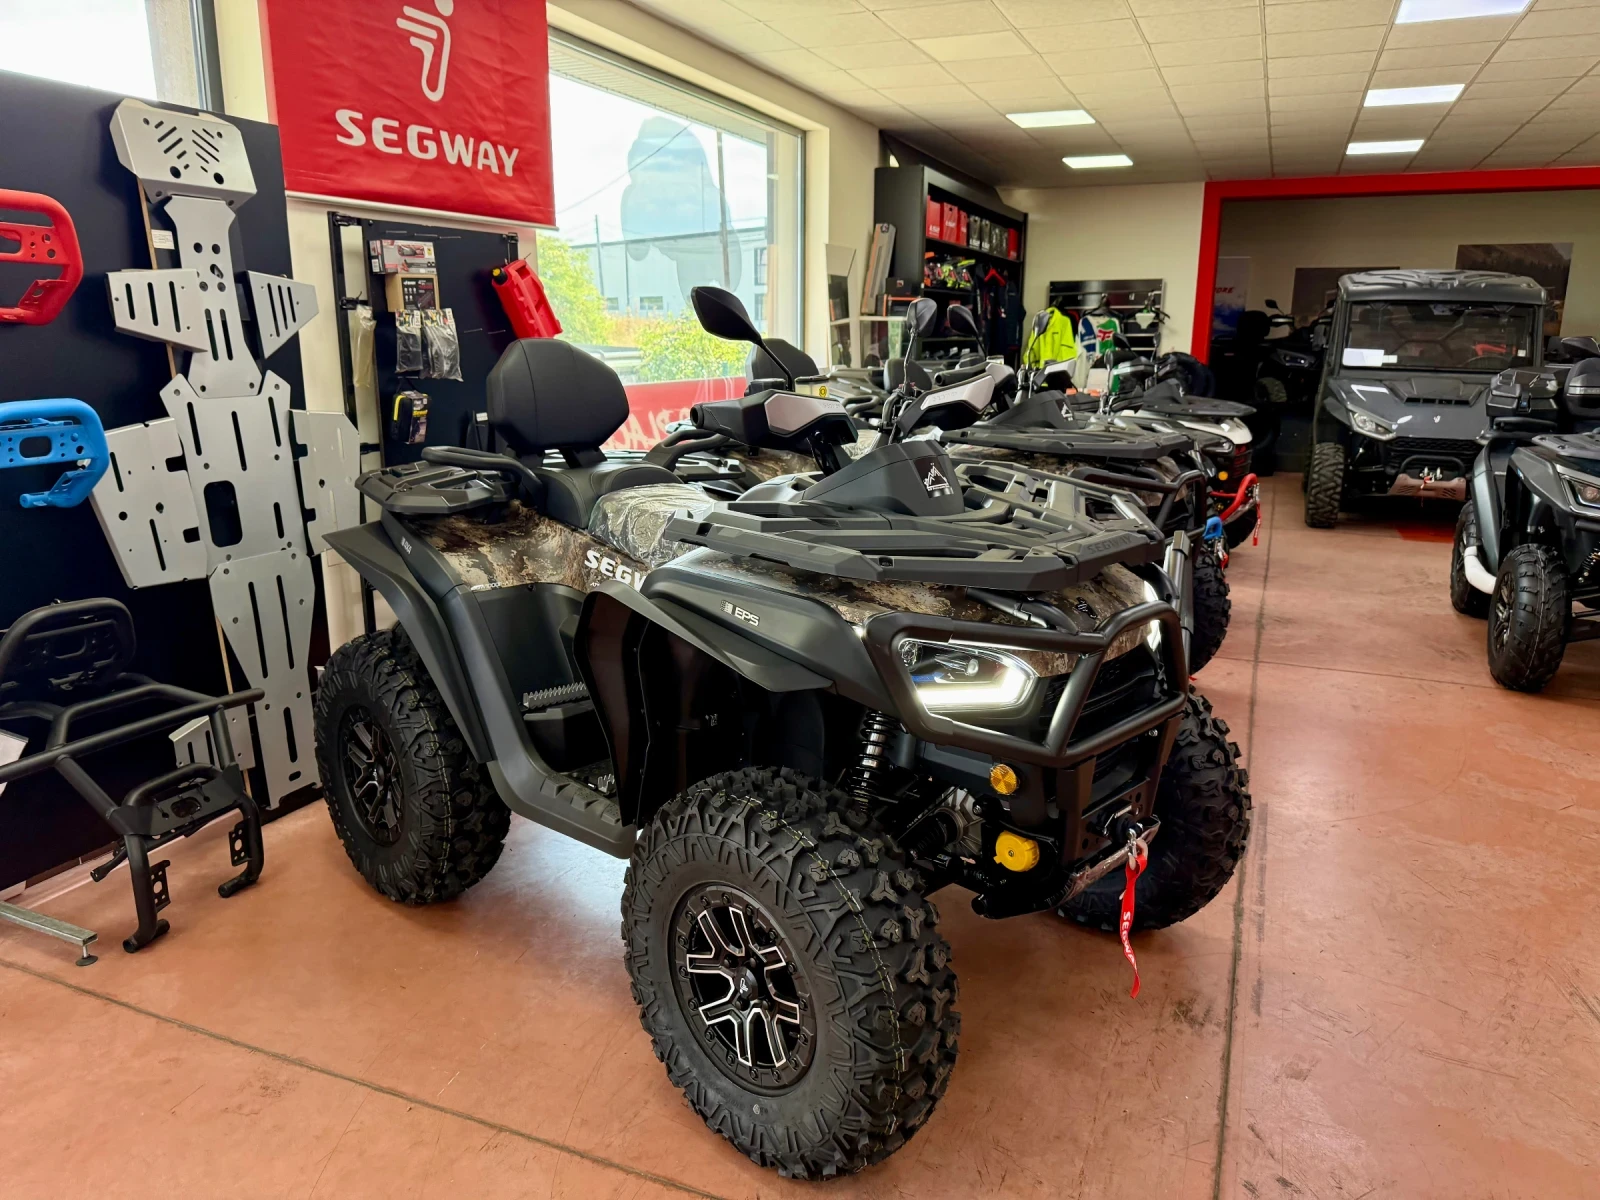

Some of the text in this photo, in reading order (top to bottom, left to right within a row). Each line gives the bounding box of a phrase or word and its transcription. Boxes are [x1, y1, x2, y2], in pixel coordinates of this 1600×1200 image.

[335, 109, 519, 177] SEGWAY
[584, 549, 646, 592] SEGW
[734, 606, 760, 627] EPS
[1122, 911, 1136, 969] SEGWA
